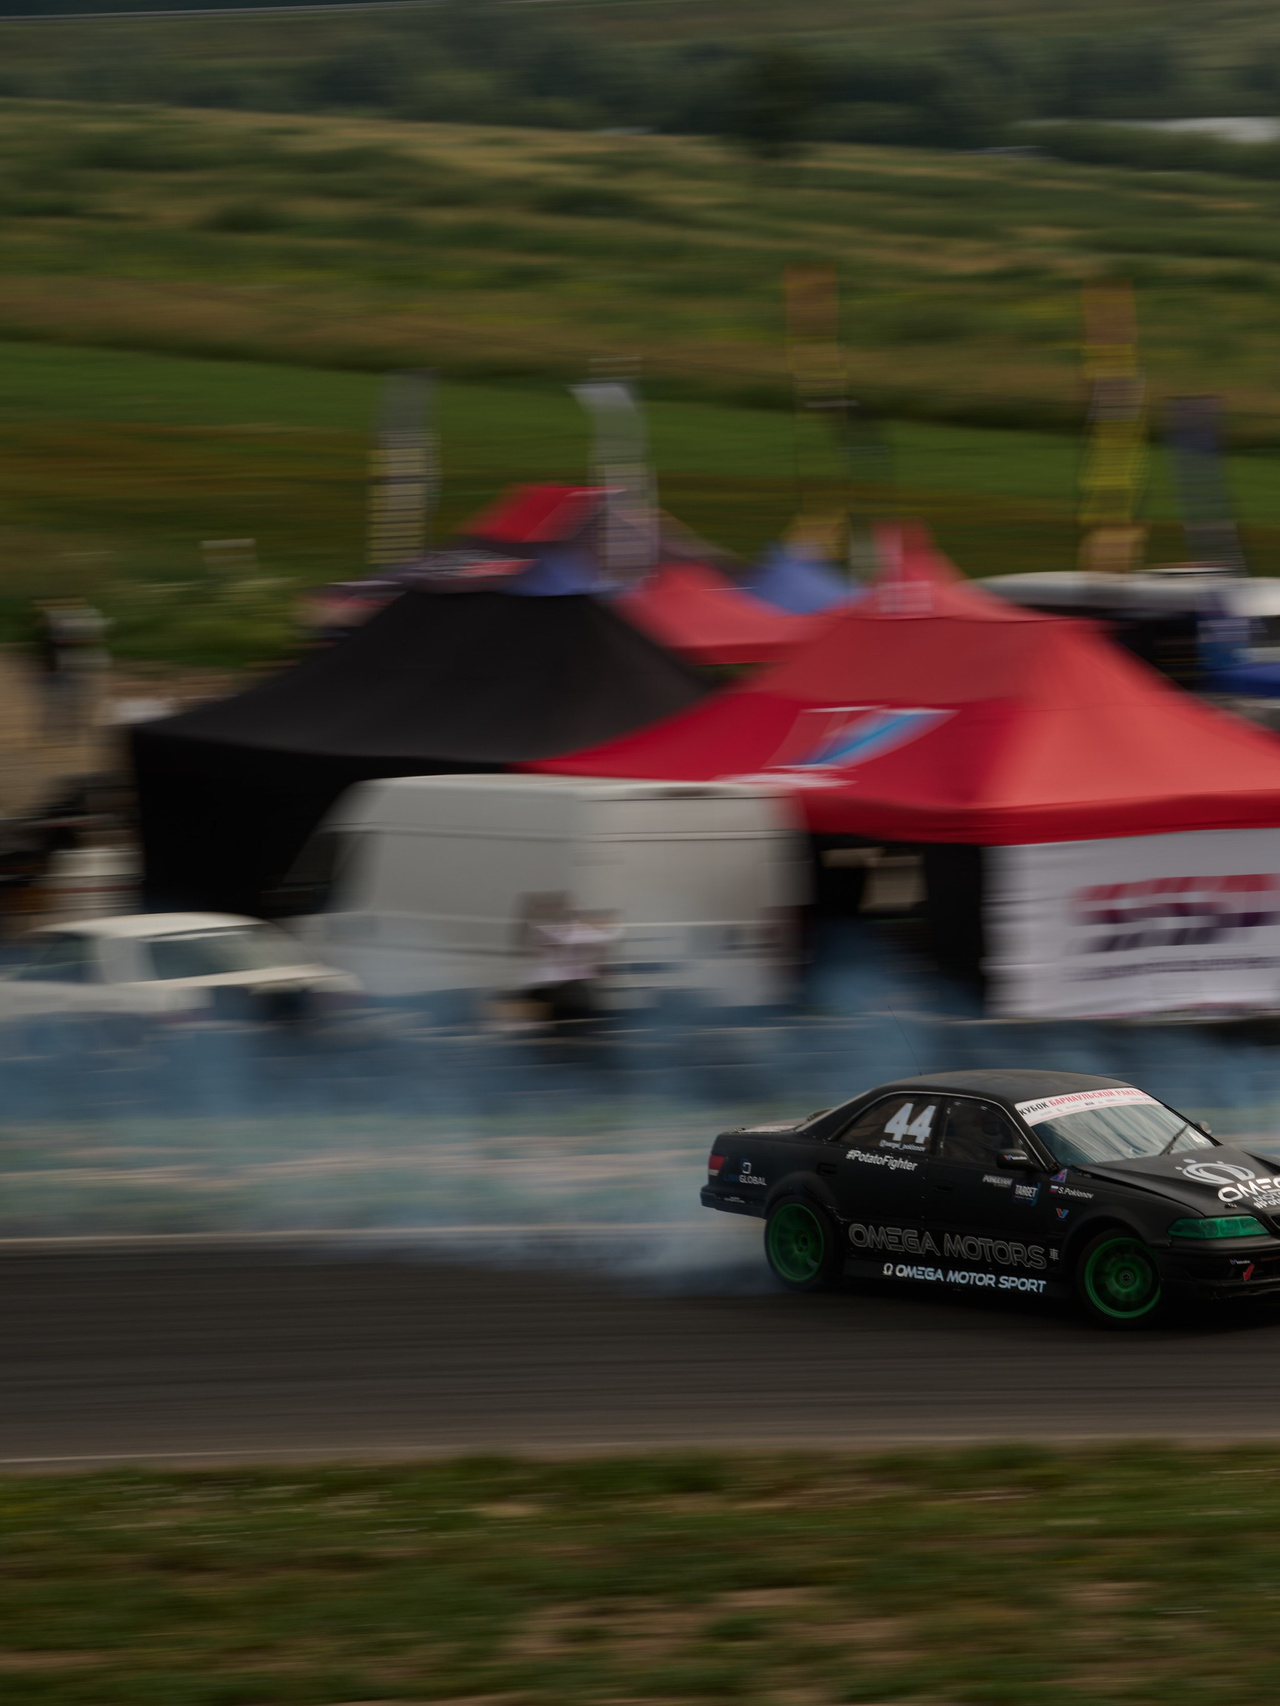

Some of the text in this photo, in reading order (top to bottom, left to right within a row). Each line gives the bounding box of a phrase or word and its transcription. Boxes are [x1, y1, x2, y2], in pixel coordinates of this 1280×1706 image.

[1018, 1101, 1048, 1116] КУБОК
[1048, 1089, 1114, 1107] БАРНАУЛЬСКОЙ
[883, 1102, 937, 1144] 44
[845, 1149, 918, 1171] #PotatoFighter
[1015, 1184, 1038, 1198] TARGET
[848, 1223, 1048, 1270] OMEGA MOTORS
[895, 1264, 944, 1282] OMEGA
[946, 1269, 996, 1288] MOTOR
[997, 1275, 1047, 1293] SPORT
